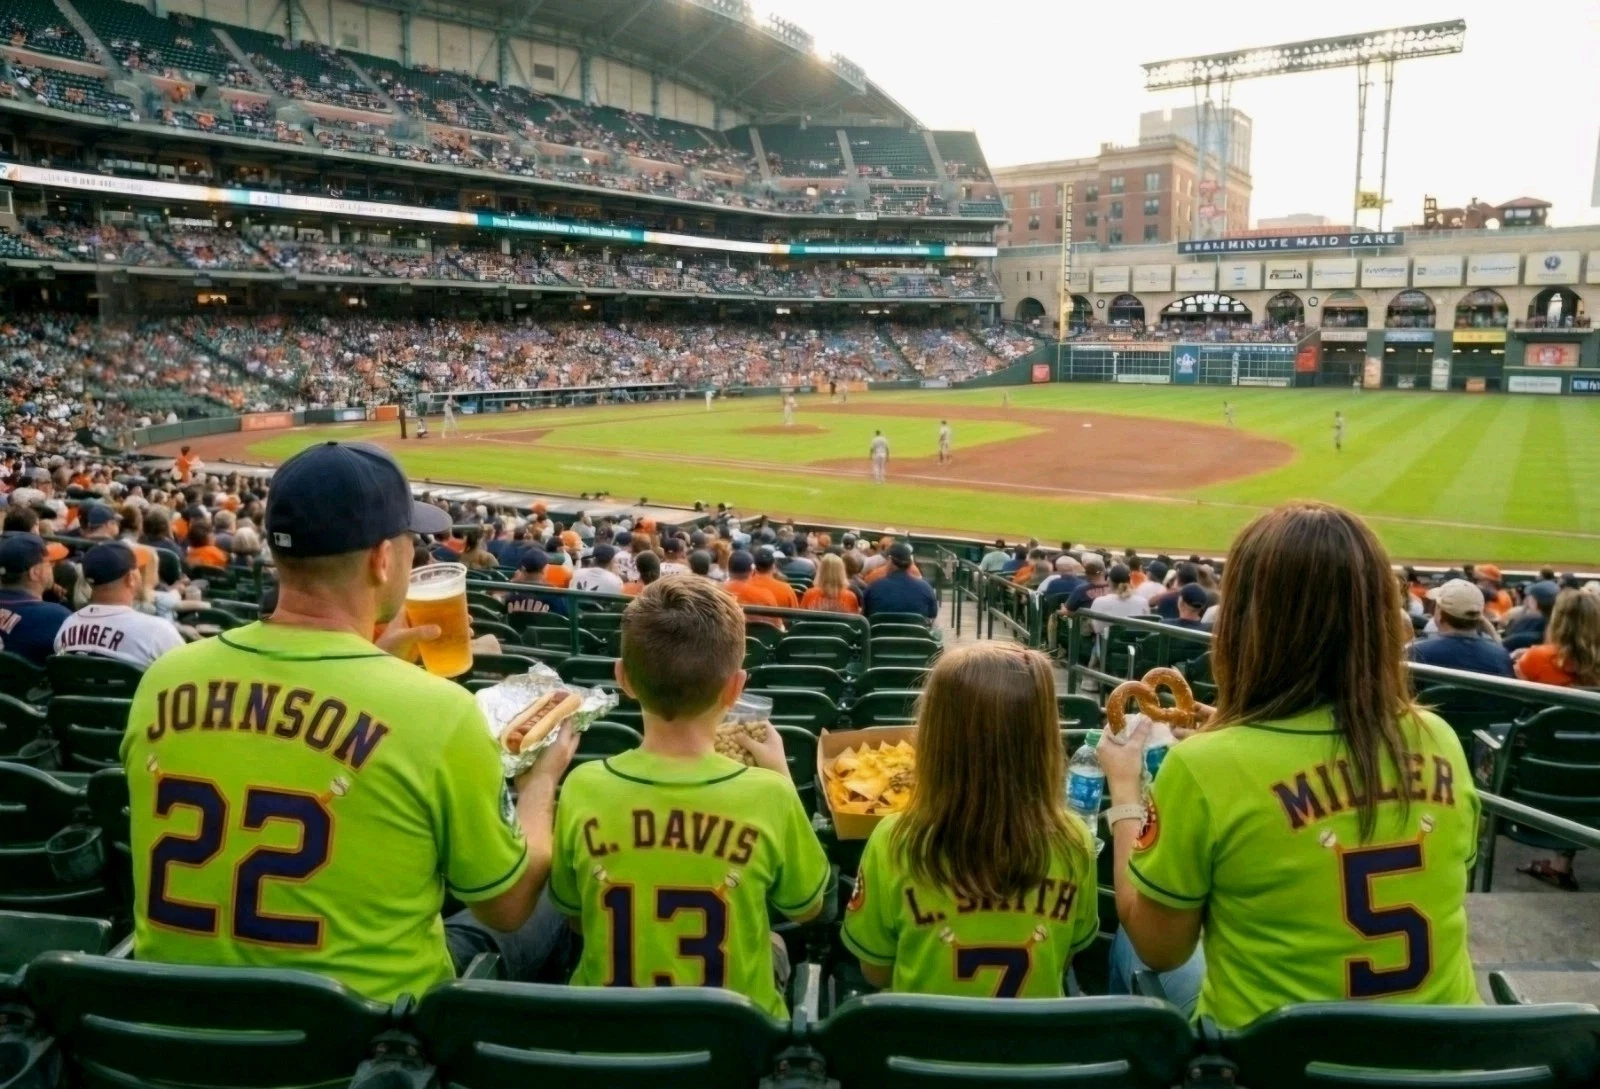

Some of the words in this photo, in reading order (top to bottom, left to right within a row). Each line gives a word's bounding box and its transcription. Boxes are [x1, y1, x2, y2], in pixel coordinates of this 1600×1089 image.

[1228, 237, 1288, 249] MINUTE
[1296, 235, 1339, 246] MAID
[147, 680, 390, 772] JOHNSON
[1271, 752, 1456, 831] MILLER
[147, 773, 337, 949] 22
[584, 816, 619, 858] C.
[632, 808, 760, 866] DAVIS
[601, 882, 731, 987] 13
[904, 886, 945, 925] L.
[1337, 840, 1434, 999] 5
